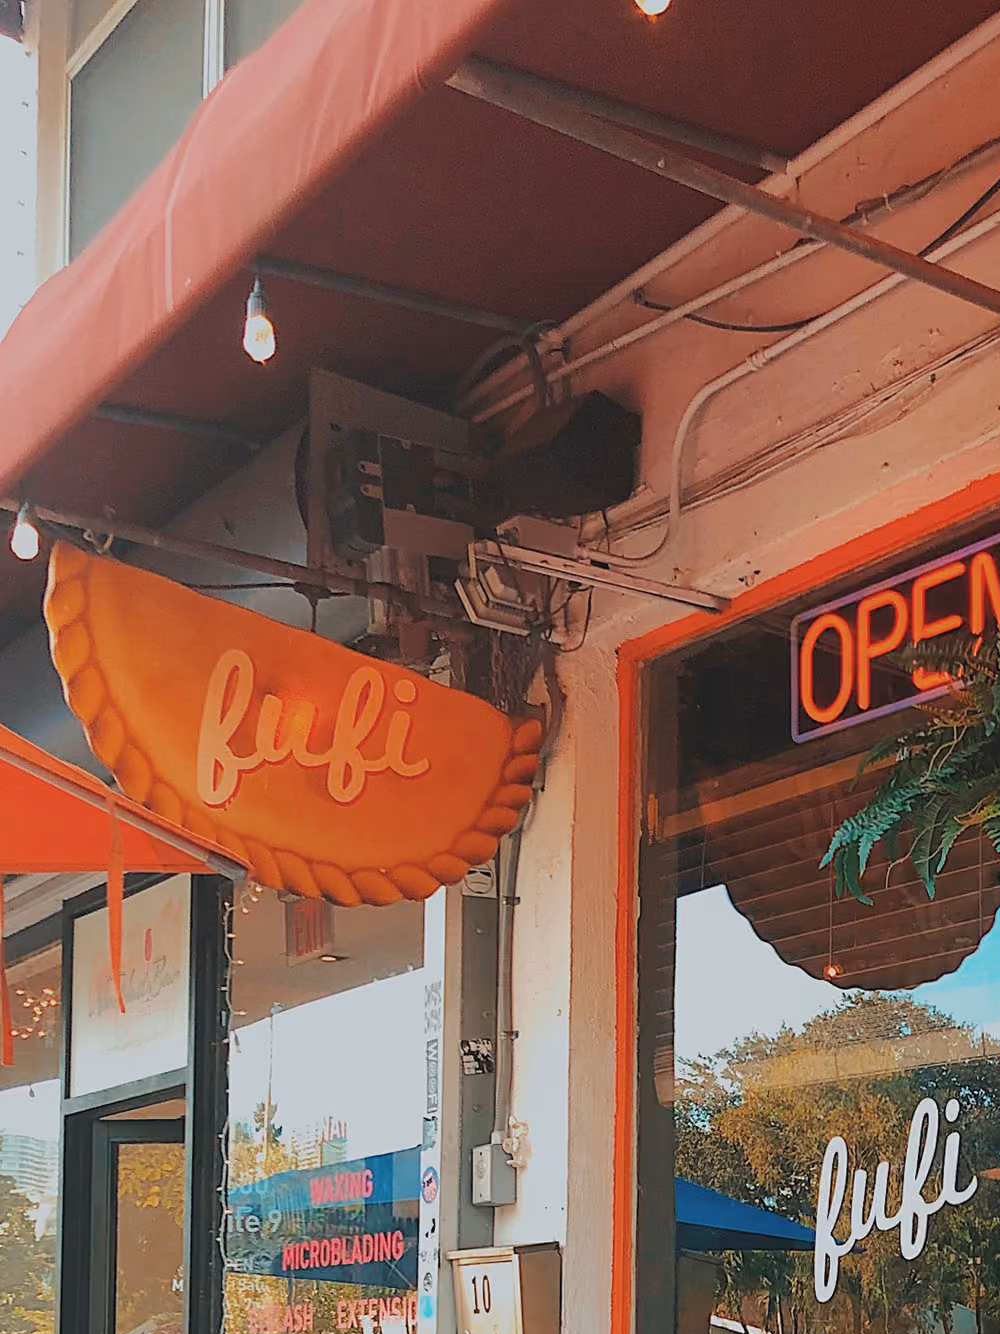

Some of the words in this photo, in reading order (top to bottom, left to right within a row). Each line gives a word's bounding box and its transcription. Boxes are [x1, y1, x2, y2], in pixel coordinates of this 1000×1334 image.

[197, 649, 430, 807] fufi
[309, 1168, 374, 1204] WAXING
[814, 1098, 978, 1303] fufi
[281, 1230, 405, 1271] MICROBLADING
[472, 1275, 491, 1314] 10
